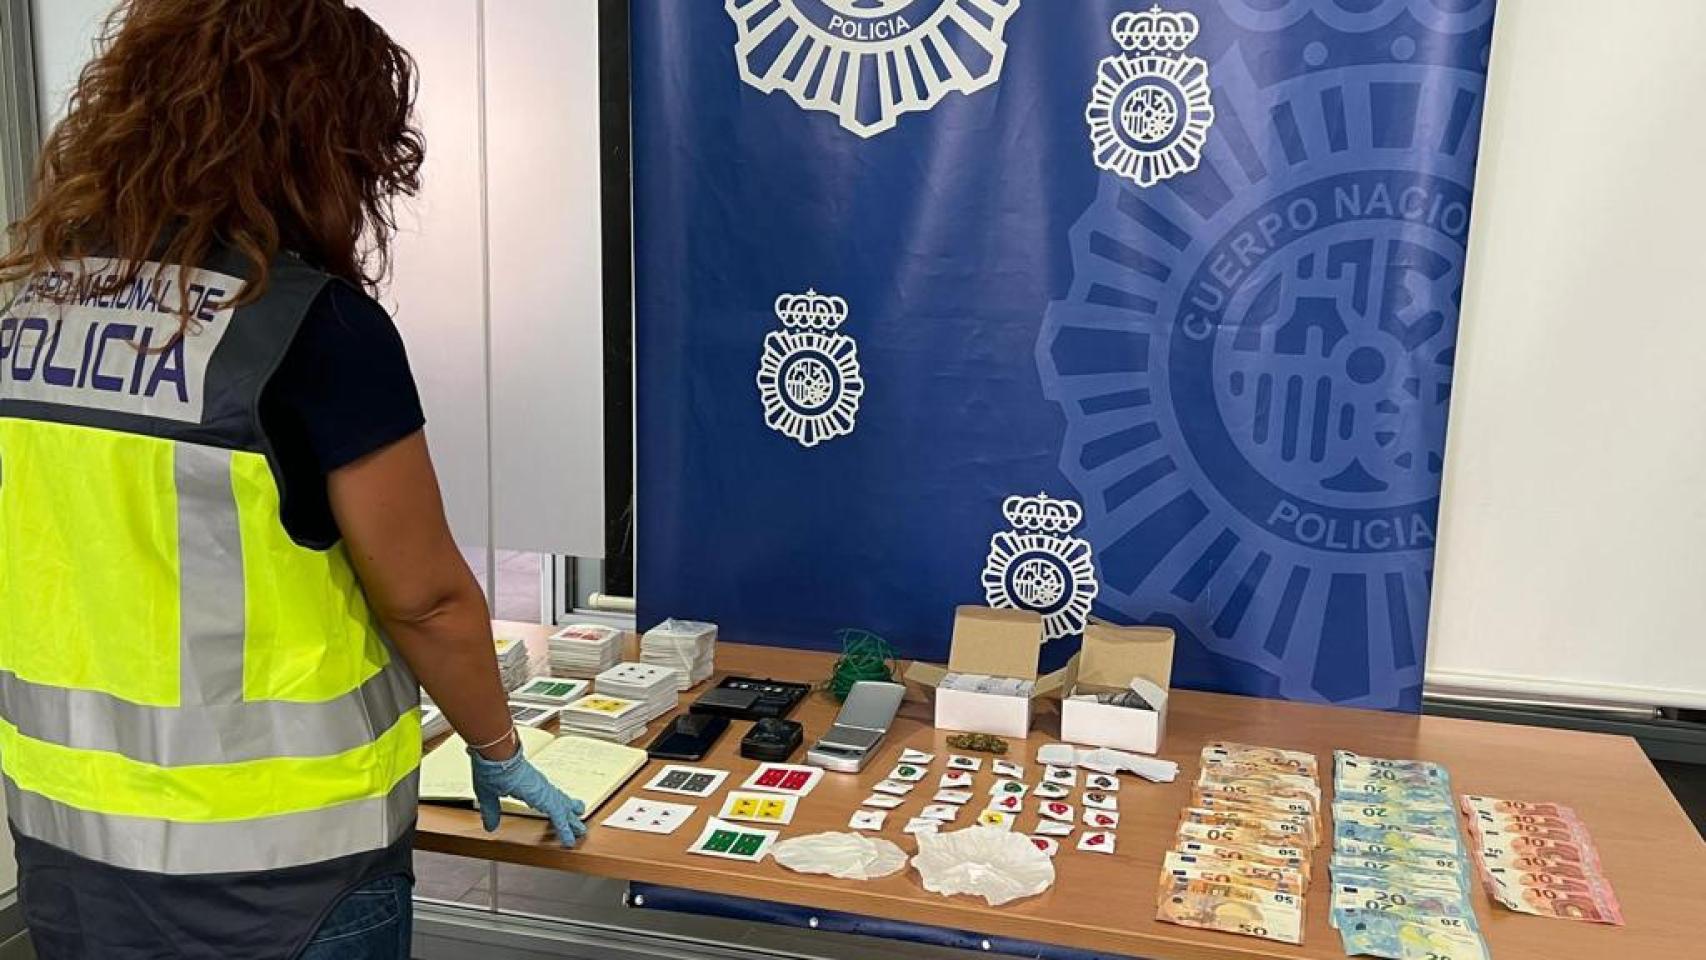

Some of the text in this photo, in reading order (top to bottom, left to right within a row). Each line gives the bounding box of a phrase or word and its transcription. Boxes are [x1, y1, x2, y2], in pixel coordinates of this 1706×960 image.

[828, 15, 911, 40] POLICIA
[1182, 198, 1318, 340] CUERPO
[0, 318, 188, 403] POLICIA
[1267, 499, 1436, 550] POLICIA
